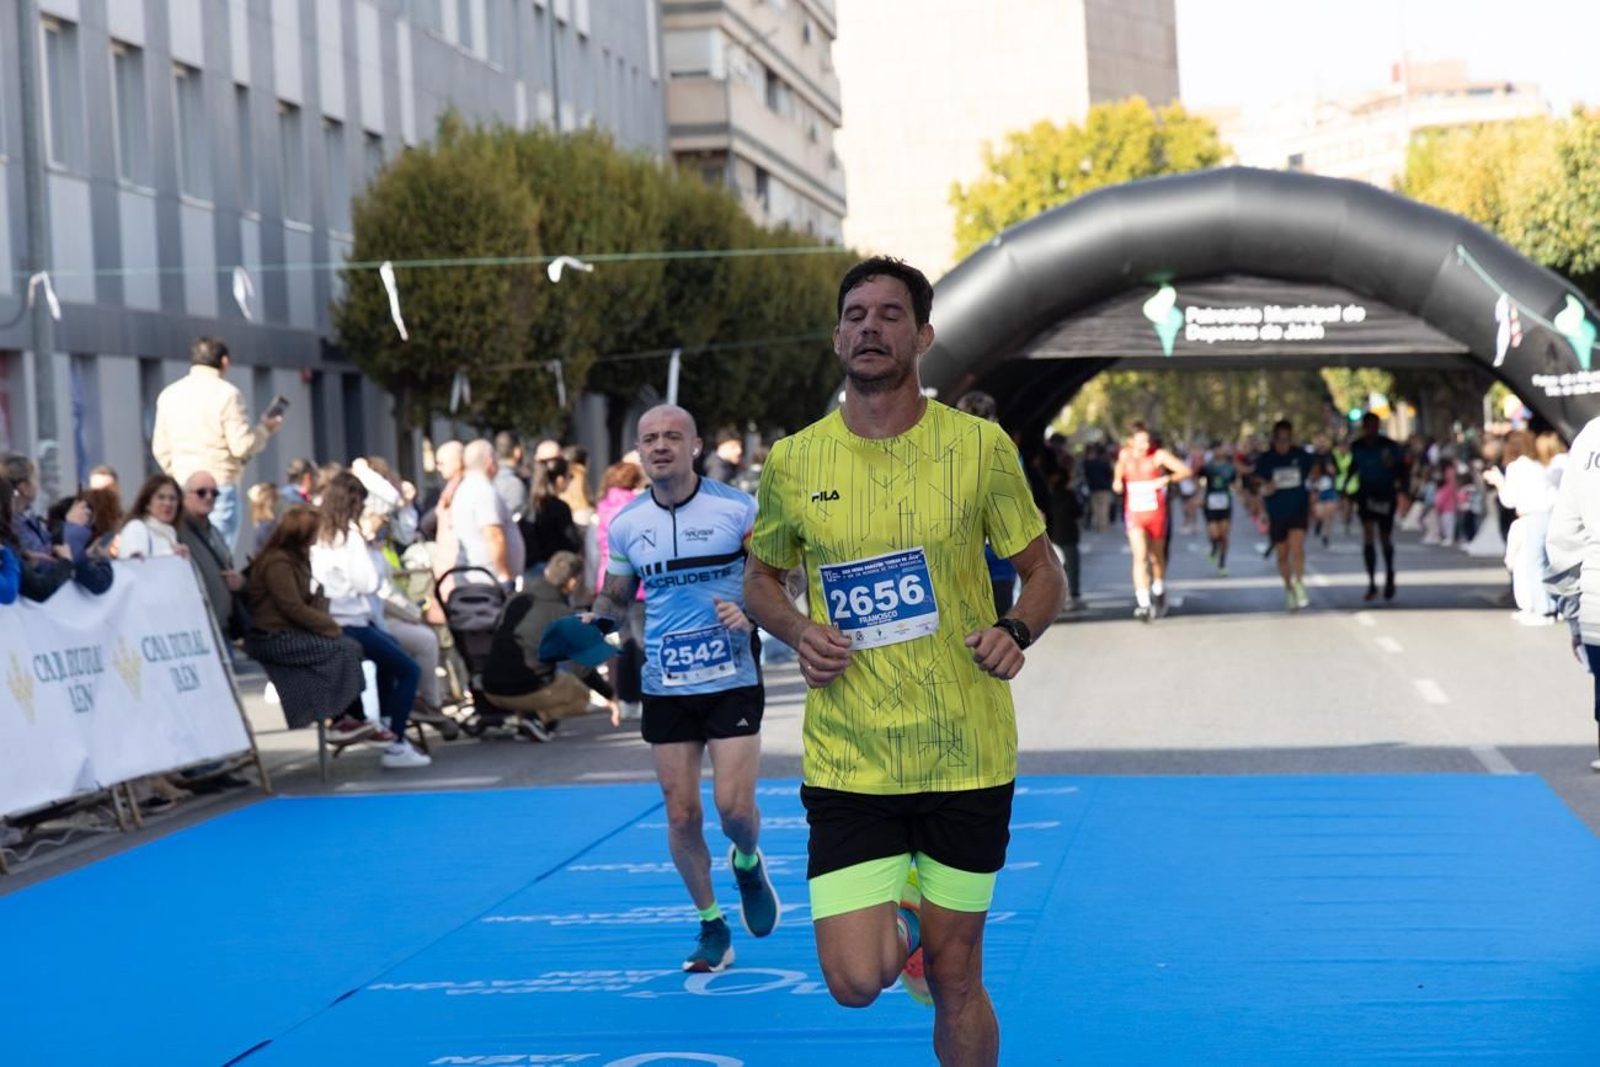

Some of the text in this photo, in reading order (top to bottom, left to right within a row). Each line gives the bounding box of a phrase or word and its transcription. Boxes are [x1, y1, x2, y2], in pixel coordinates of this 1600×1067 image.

[811, 490, 840, 503] FILA
[830, 574, 925, 619] 2656
[859, 610, 898, 625] FRANCISCO
[663, 640, 727, 667] 2542
